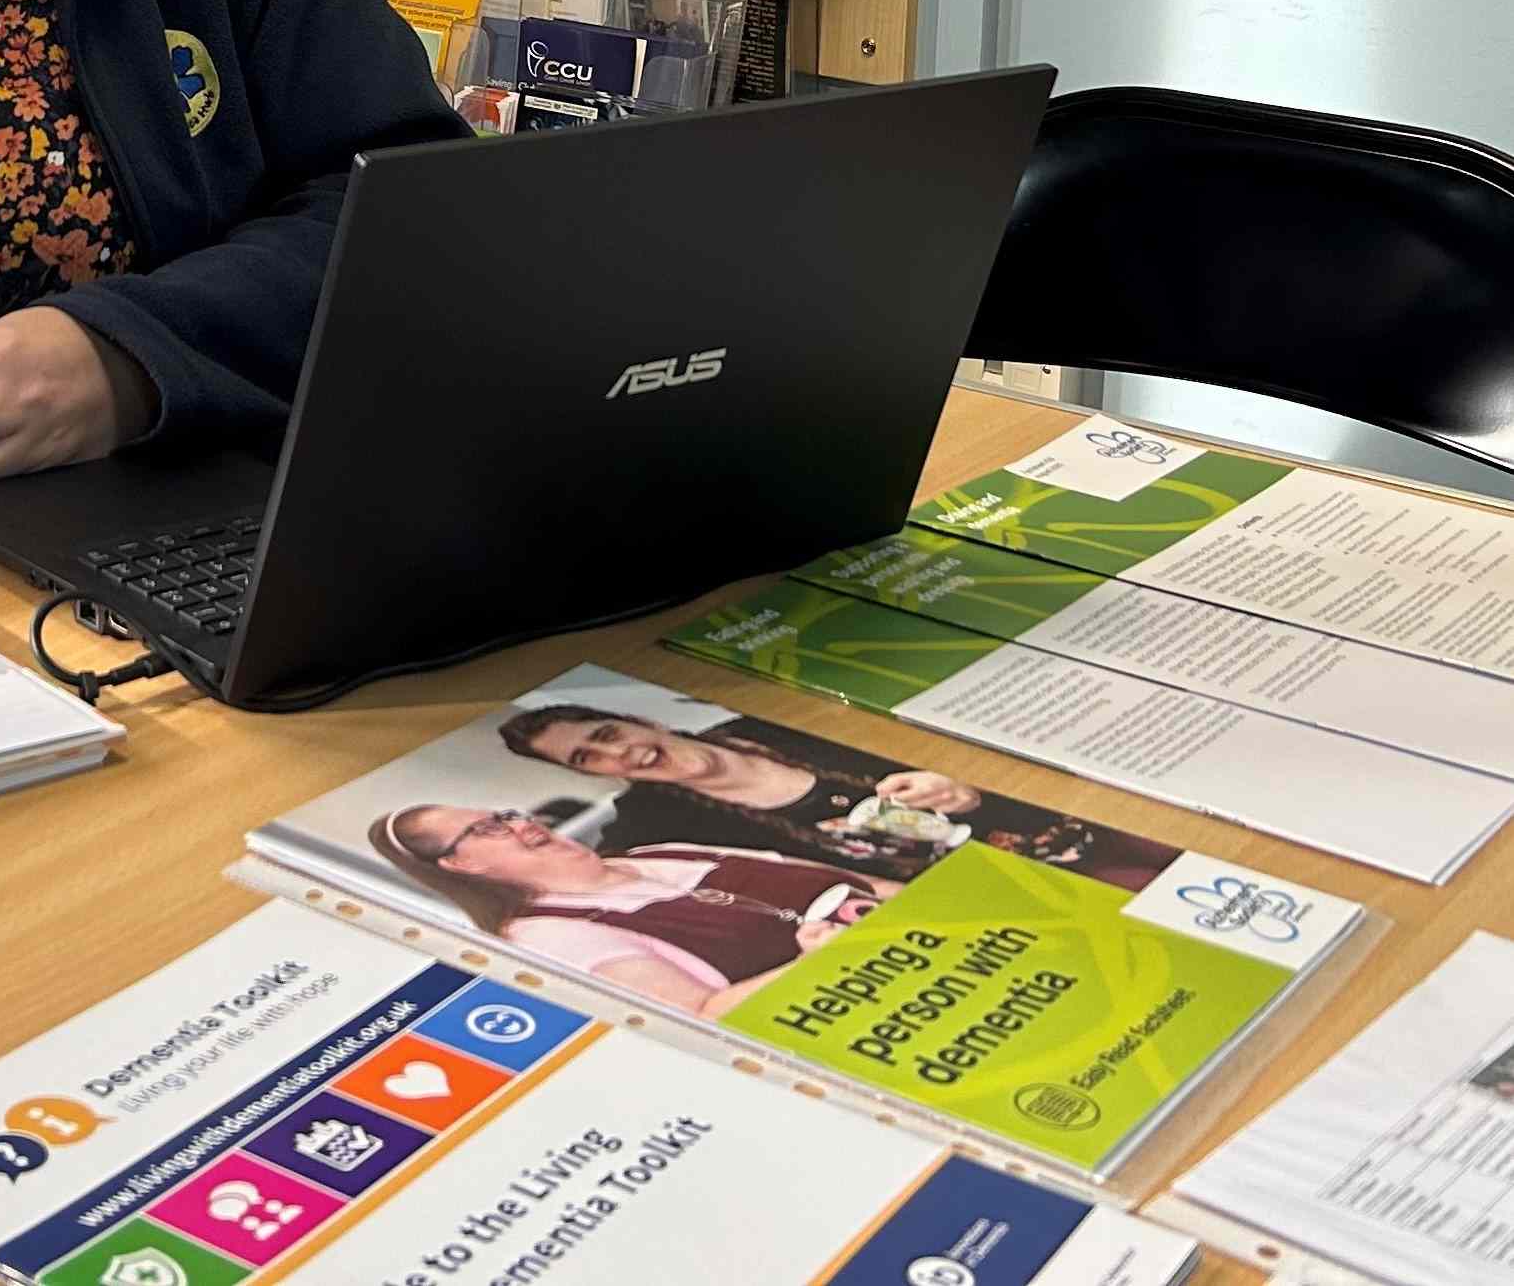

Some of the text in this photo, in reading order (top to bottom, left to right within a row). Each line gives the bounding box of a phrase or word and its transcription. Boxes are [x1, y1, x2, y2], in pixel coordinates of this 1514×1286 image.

[543, 61, 593, 81] CCU
[606, 347, 727, 400] ASUS
[83, 960, 310, 1099] Dementia Toolkit
[773, 928, 949, 1038] Helping a
[847, 925, 1041, 1066] person with
[913, 968, 1079, 1086] dementia
[77, 998, 419, 1229] www.livingwithdementiatoolkit.org.uk
[598, 1115, 713, 1195] Toolkit
[421, 1127, 624, 1275] to the Living
